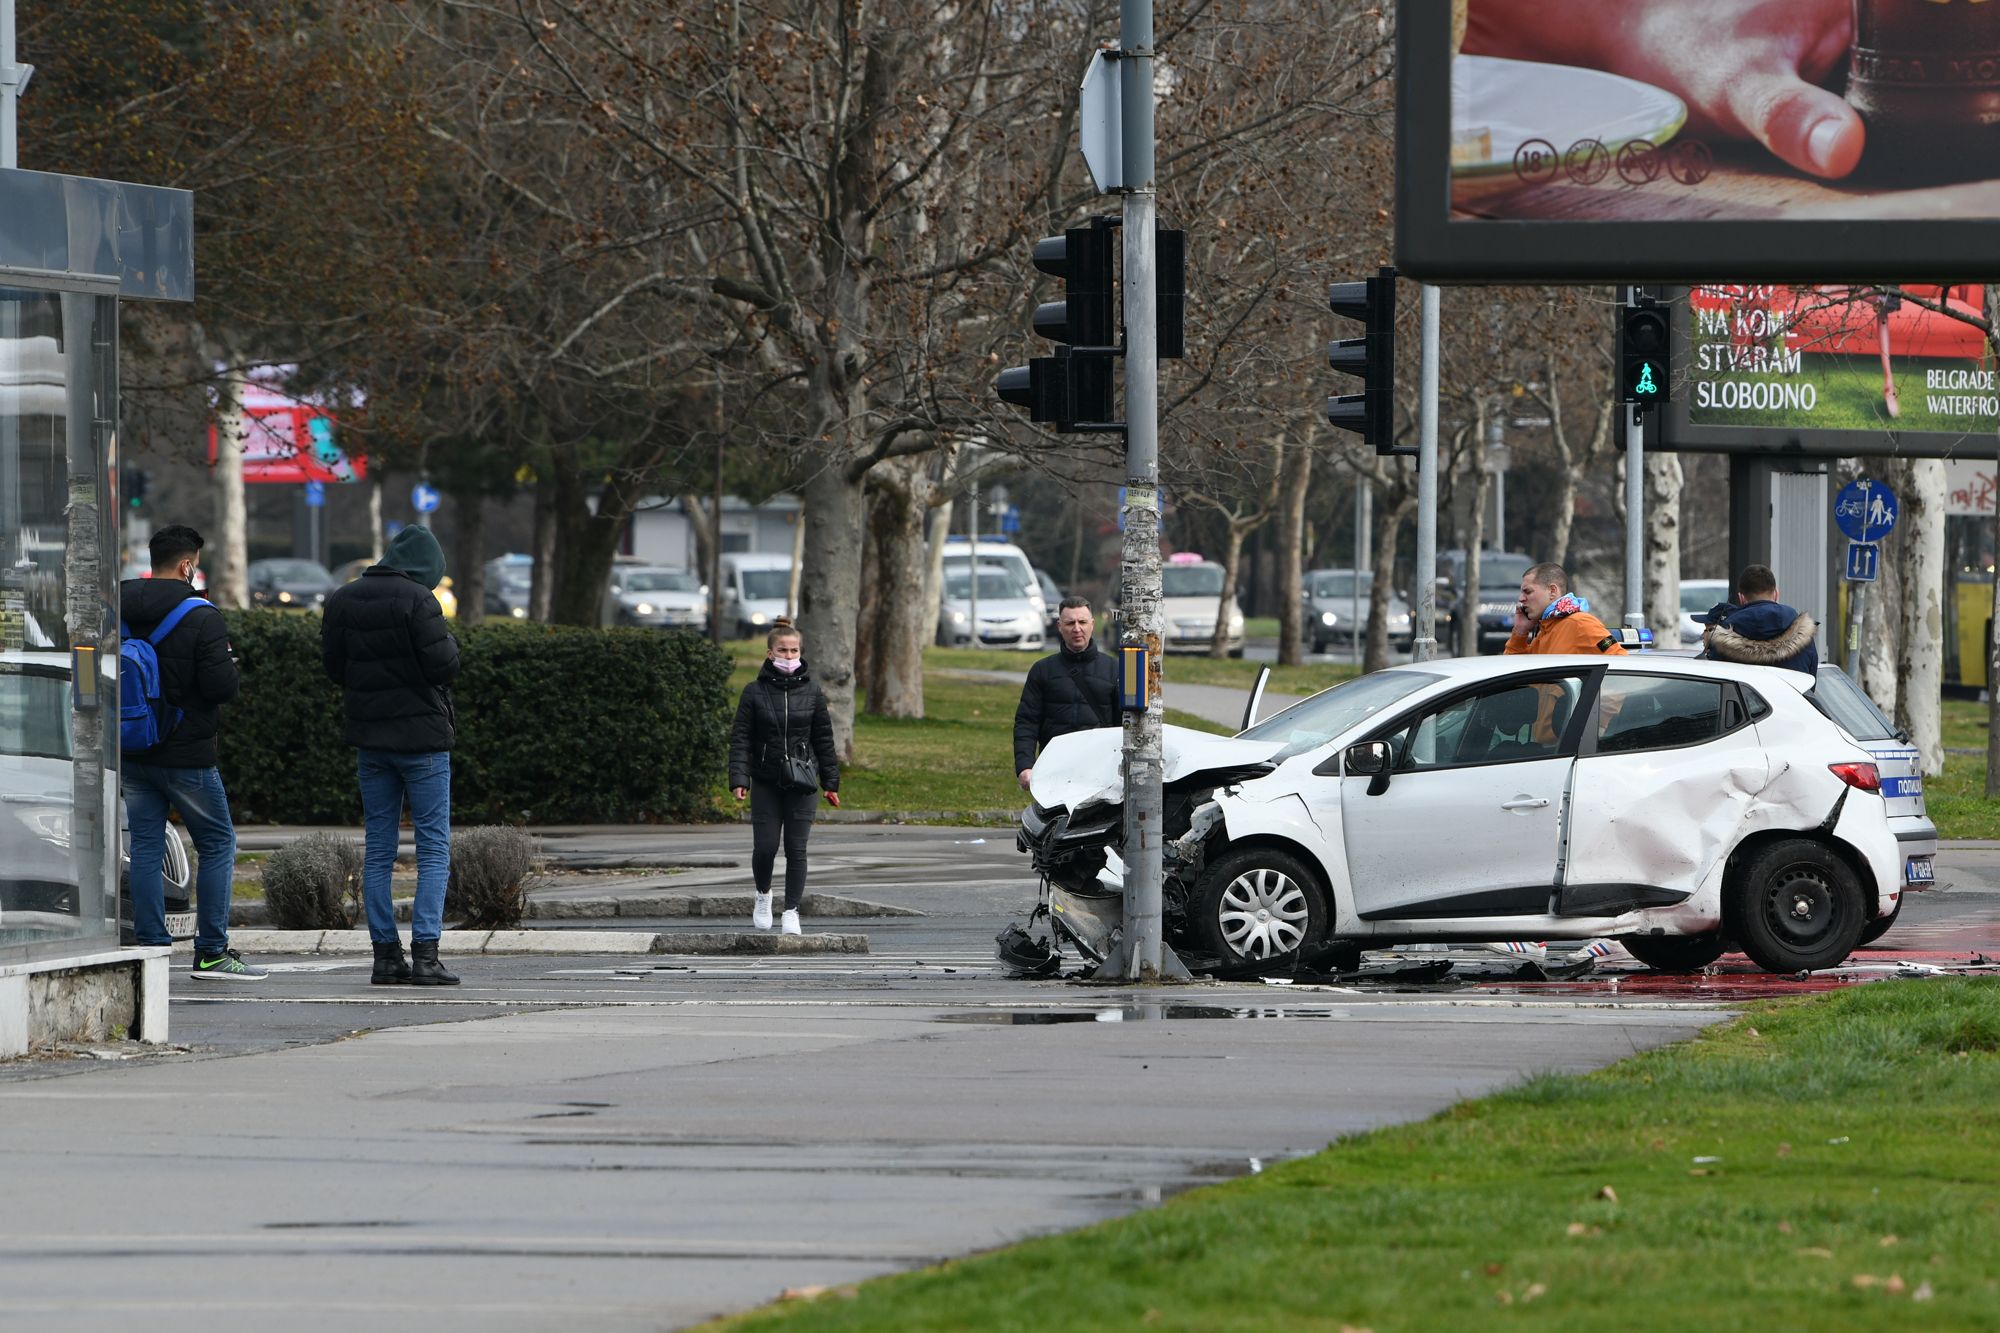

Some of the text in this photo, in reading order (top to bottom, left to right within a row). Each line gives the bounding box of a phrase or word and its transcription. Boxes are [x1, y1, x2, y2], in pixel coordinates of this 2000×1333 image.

[1522, 149, 1551, 173] 18+
[1699, 308, 1798, 338] NA KOME
[1698, 344, 1801, 374] STVARAM
[1926, 368, 1995, 391] BELGRADE
[1697, 381, 1817, 411] SLOBODNO
[1926, 395, 1999, 416] WATERFRO
